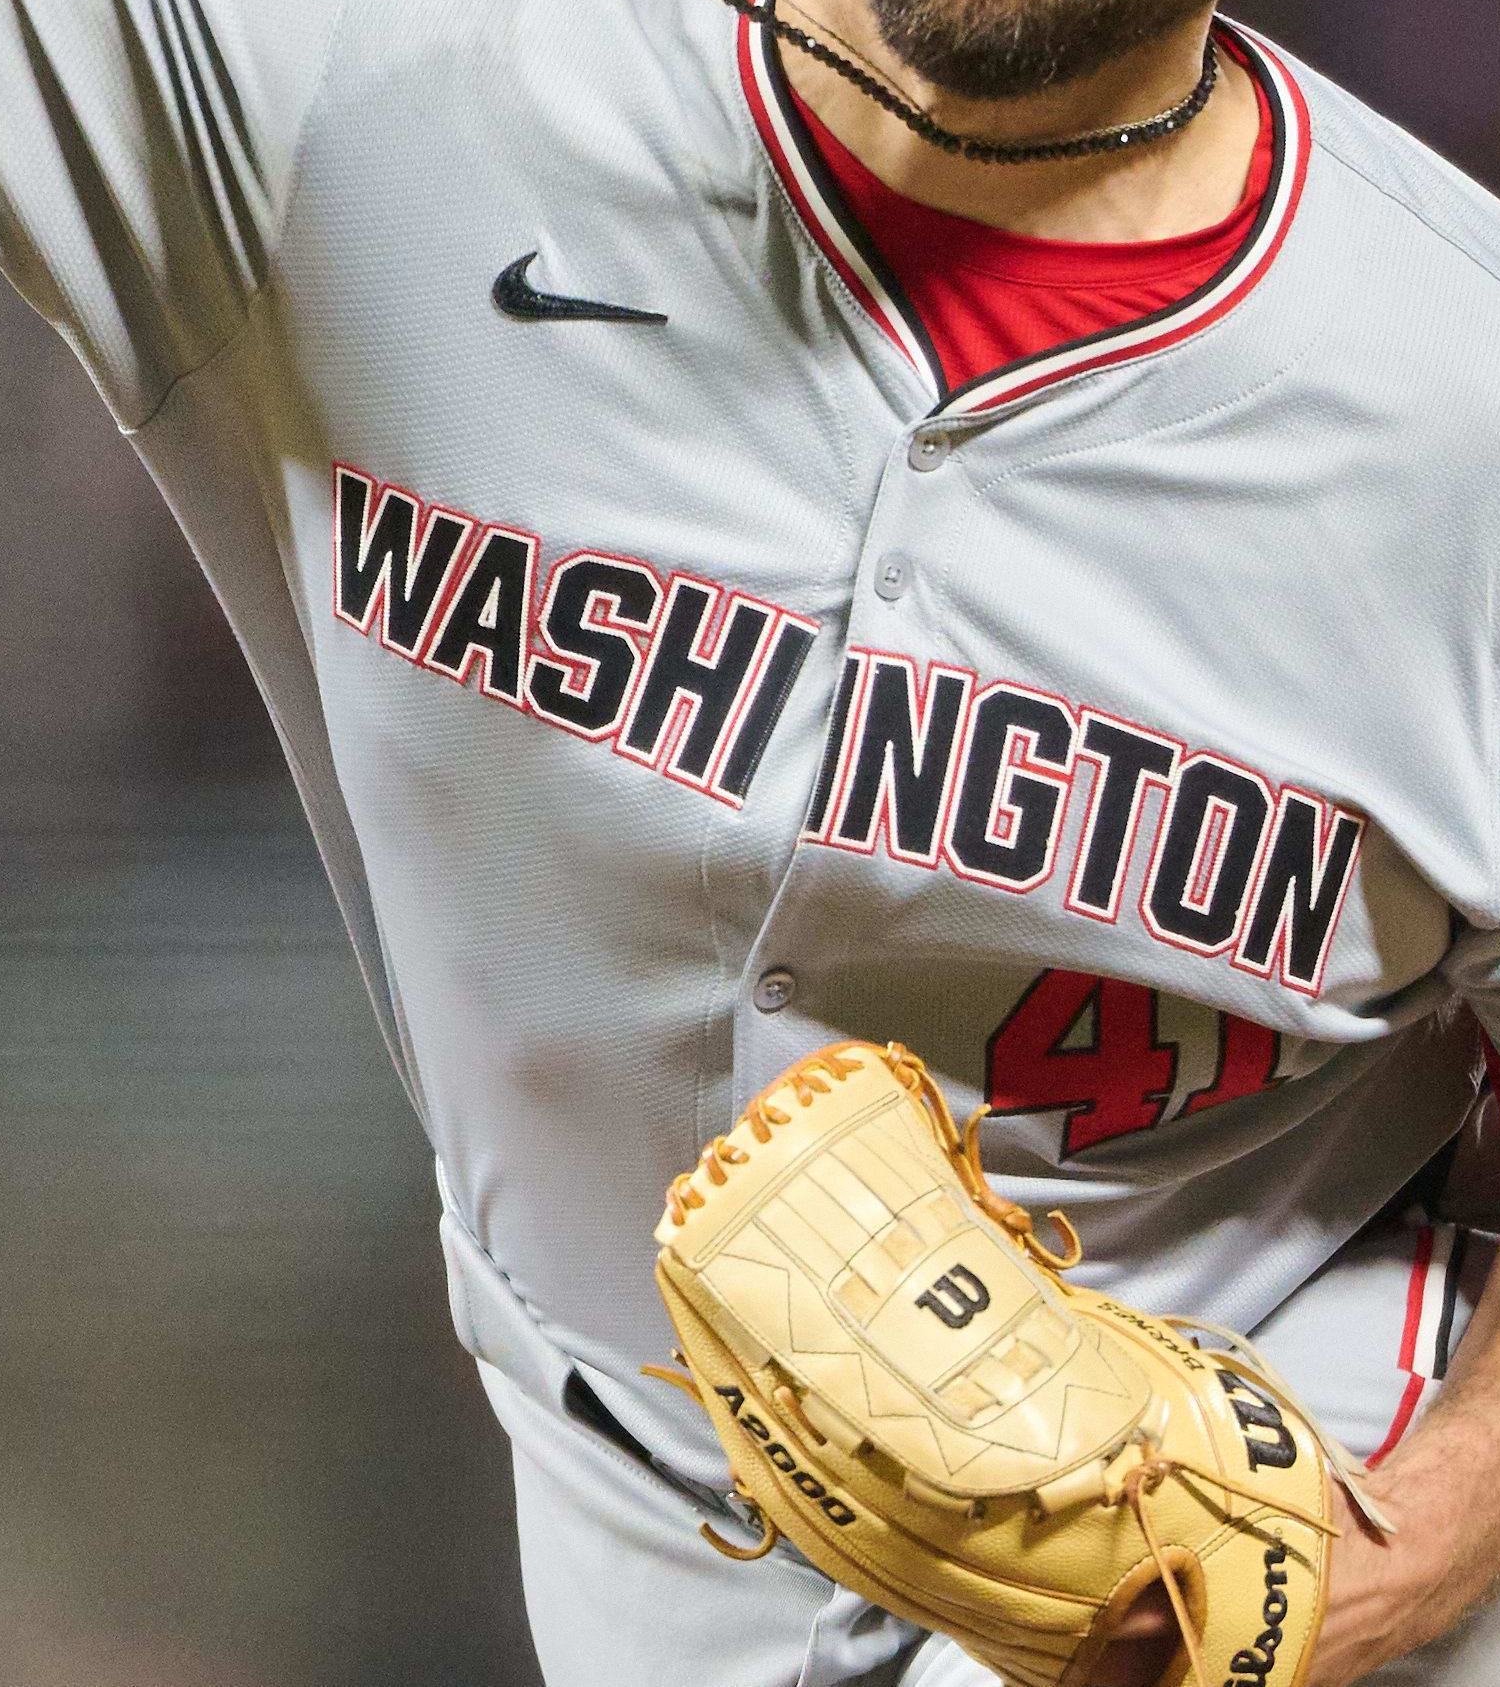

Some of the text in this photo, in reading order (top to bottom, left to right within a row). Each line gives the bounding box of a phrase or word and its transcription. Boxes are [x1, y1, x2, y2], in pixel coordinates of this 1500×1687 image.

[333, 462, 1365, 1000] WASHINGTON
[984, 967, 1292, 1163] 41
[913, 1262, 991, 1329] W
[713, 1385, 857, 1527] A2000
[1214, 1367, 1298, 1474] W
[1222, 1541, 1288, 1687] ilson
